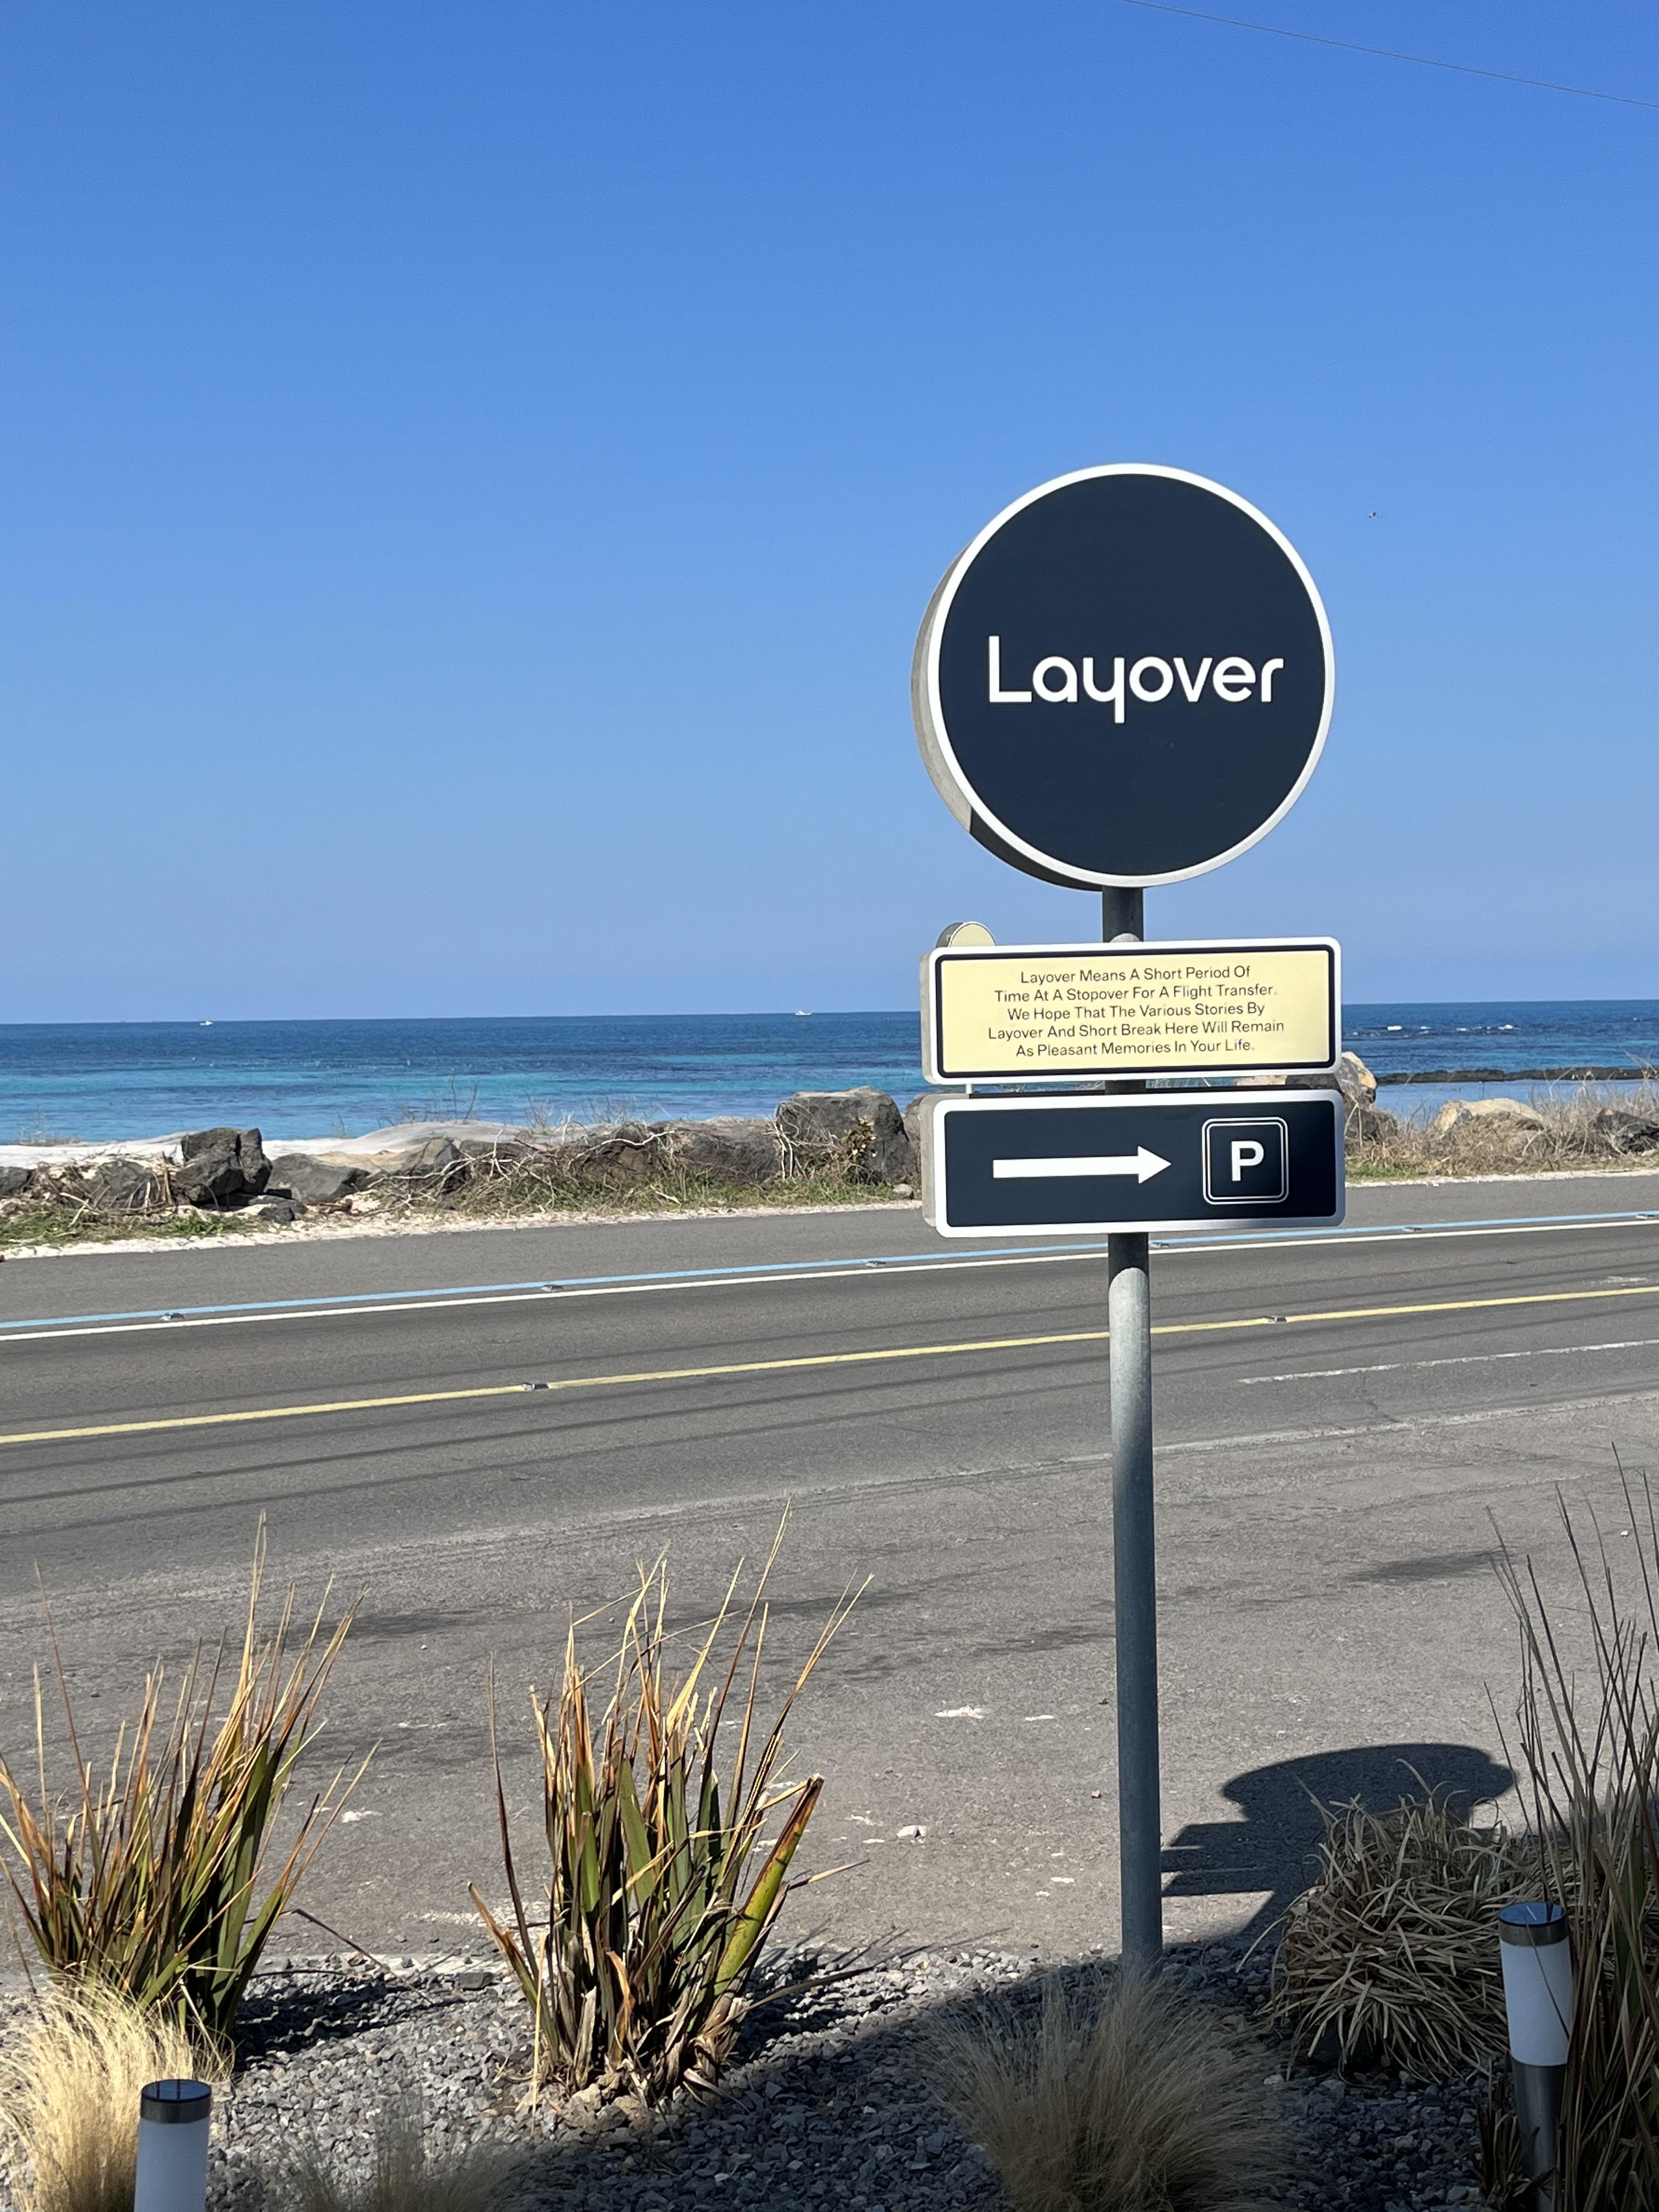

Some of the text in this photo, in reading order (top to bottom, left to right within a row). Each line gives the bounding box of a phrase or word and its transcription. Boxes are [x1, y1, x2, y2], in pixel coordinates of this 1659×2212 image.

[989, 636, 1284, 723] Layover
[1020, 964, 1251, 986] Layover Means A Short Period Of
[994, 983, 1278, 1003] Time At A Stopover For A Flight Transfer.
[1007, 1001, 1265, 1022] We Hope That The Various Stories By
[988, 1018, 1284, 1042] Layover And Short Break Here Will Remain
[1015, 1037, 1255, 1057] As Pleasant Memories In Your Life.
[1231, 1141, 1264, 1181] P
